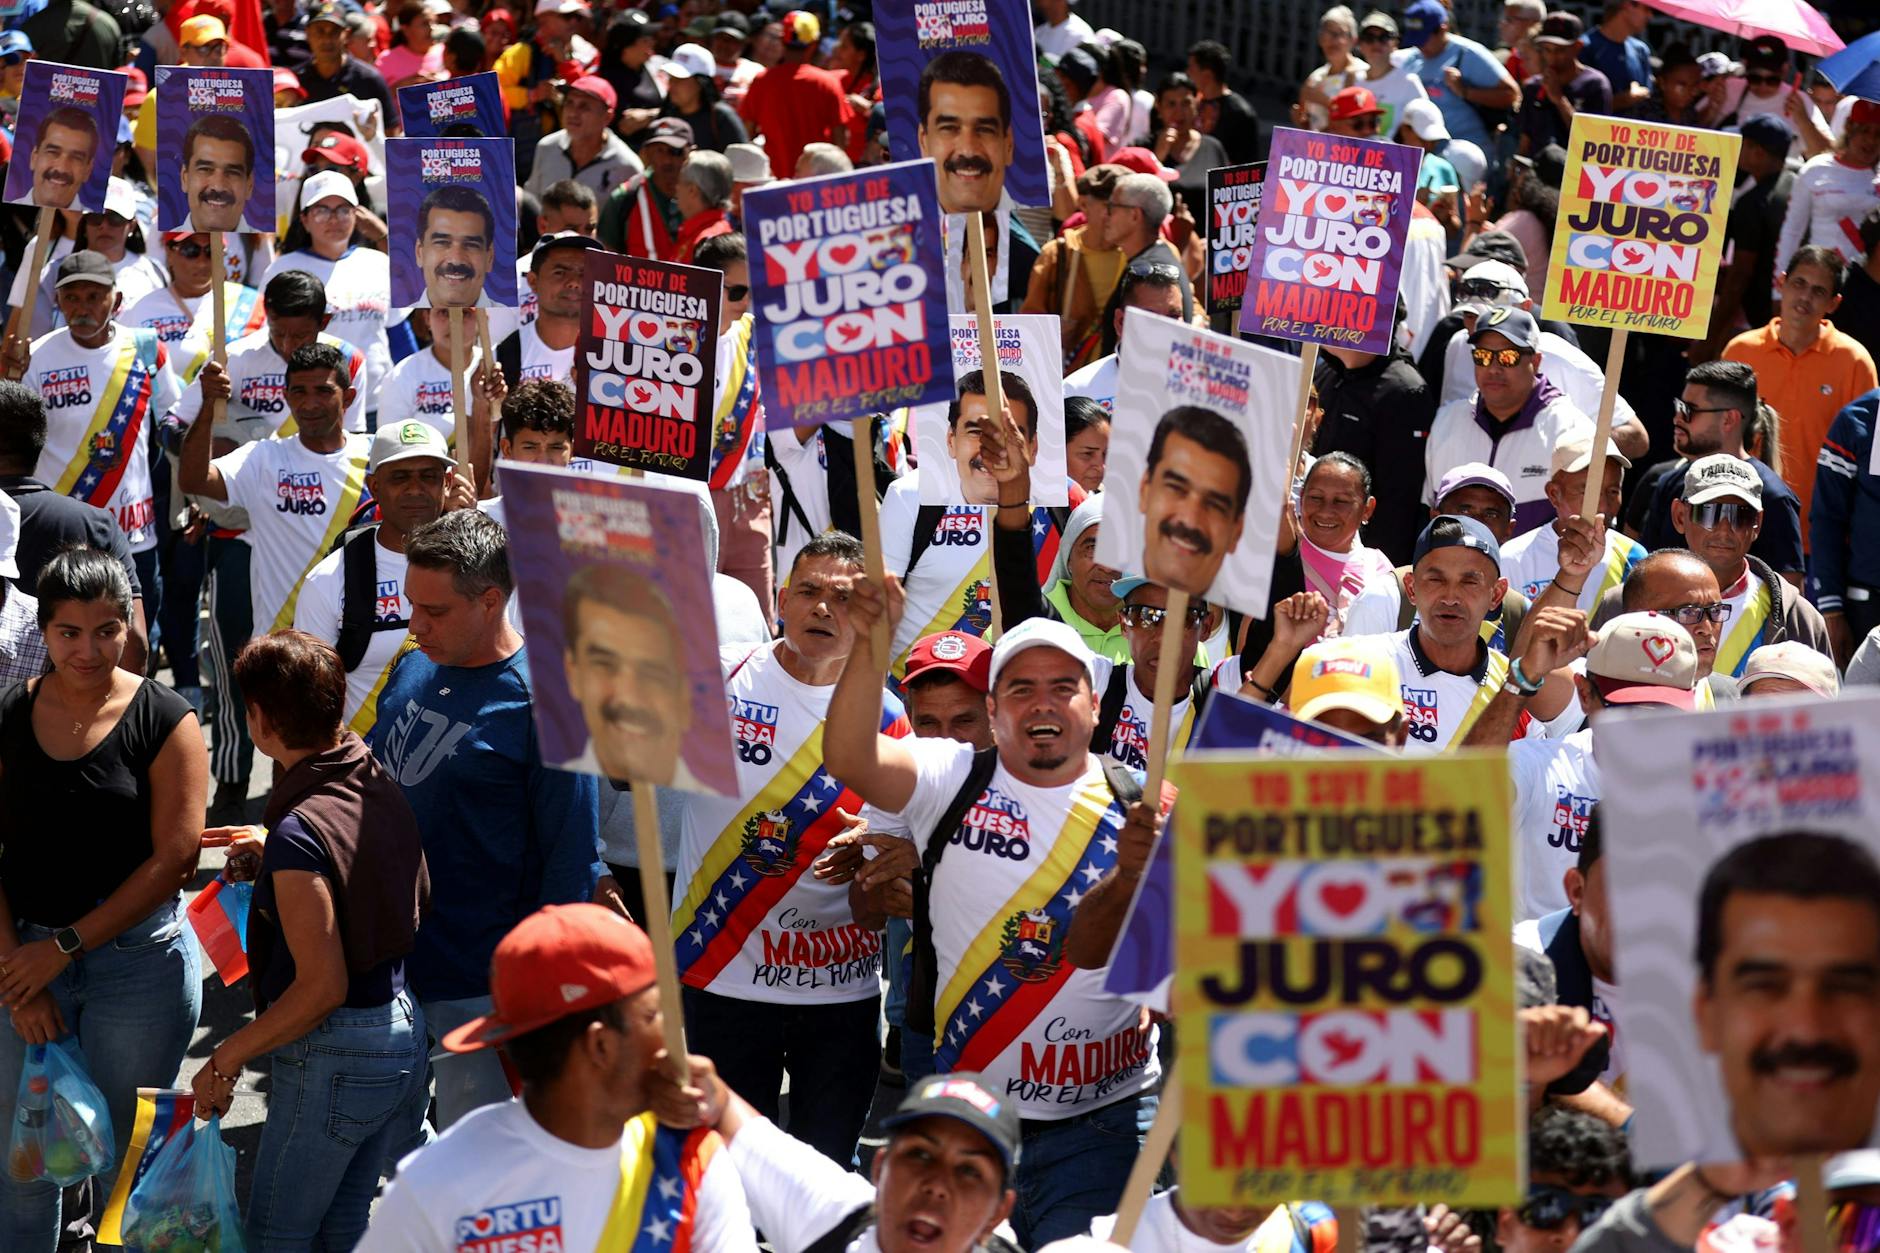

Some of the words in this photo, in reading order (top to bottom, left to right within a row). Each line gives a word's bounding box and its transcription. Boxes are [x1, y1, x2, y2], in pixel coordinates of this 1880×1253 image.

[914, 0, 986, 16] PORTUGUESA
[952, 13, 988, 25] JURO
[917, 26, 953, 39] CON
[188, 78, 244, 88] PORTUGUESA
[215, 88, 244, 97] JURO
[188, 96, 216, 105] CON
[451, 95, 475, 106] JURO
[421, 149, 480, 159] PORTUGUESA
[1306, 140, 1325, 159] YO
[1330, 143, 1360, 163] SOY
[1364, 148, 1385, 168] DE
[1611, 125, 1631, 144] YO
[1637, 128, 1670, 151] SOY
[1675, 132, 1697, 152] DE
[422, 167, 451, 176] CON
[451, 158, 481, 167] JURO
[1278, 156, 1402, 194] PORTUGUESA
[1581, 141, 1720, 178] PORTUGUESA
[788, 191, 812, 213] YO
[821, 185, 857, 207] SOY
[865, 177, 891, 200] DE
[1278, 177, 1351, 221] YO
[1582, 164, 1667, 208] YO
[759, 195, 922, 246] PORTUGUESA
[1214, 201, 1251, 228] YO
[1568, 200, 1709, 245] JURO
[1212, 223, 1256, 251] JUR
[1264, 213, 1391, 259] JURO
[763, 233, 869, 285] YO
[1214, 246, 1253, 274] CO
[1265, 247, 1381, 295] CON
[1568, 234, 1698, 282] CON
[615, 264, 632, 284] YO
[638, 268, 664, 289] SOY
[669, 274, 688, 293] DE
[763, 263, 927, 324] JURO
[1559, 268, 1694, 319] MADURO
[593, 280, 708, 321] PORTUGUESA
[1255, 280, 1377, 332] MADURO
[1567, 303, 1598, 320] POR
[1599, 309, 1621, 325] EL
[1624, 311, 1682, 330] FUTURO
[593, 303, 665, 346] YO
[774, 300, 926, 361] CON
[951, 328, 1020, 339] PORTUESA
[1261, 315, 1290, 333] POR
[1291, 321, 1309, 336] EL
[1312, 323, 1366, 345] FUTURO
[40, 367, 87, 384] PORTU
[586, 339, 704, 386] JURO
[776, 342, 933, 407] MADURO
[43, 380, 90, 398] GUESA
[46, 390, 92, 410] JURO
[588, 371, 697, 422] CON
[794, 400, 829, 421] POR
[832, 397, 856, 414] EL
[585, 404, 696, 459] MADURO
[593, 441, 618, 457] POR
[619, 446, 637, 461] EL
[276, 496, 326, 515] JURO
[963, 806, 1030, 841] UESA
[1204, 809, 1482, 856] PORTUGUESA
[949, 827, 1030, 861] JURO
[1207, 861, 1385, 938] YO
[778, 907, 821, 930] Con
[761, 922, 881, 968] MADURO
[752, 963, 792, 987] POR
[796, 967, 826, 989] EL
[1199, 938, 1484, 1006] JURO
[1044, 1016, 1095, 1043] Con
[1021, 1025, 1149, 1086] MADURO
[1211, 1010, 1475, 1086] CON
[1006, 1077, 1052, 1103] POR
[1056, 1085, 1088, 1105] EL
[1211, 1089, 1482, 1170] MADURO
[457, 1199, 559, 1244] PORTU
